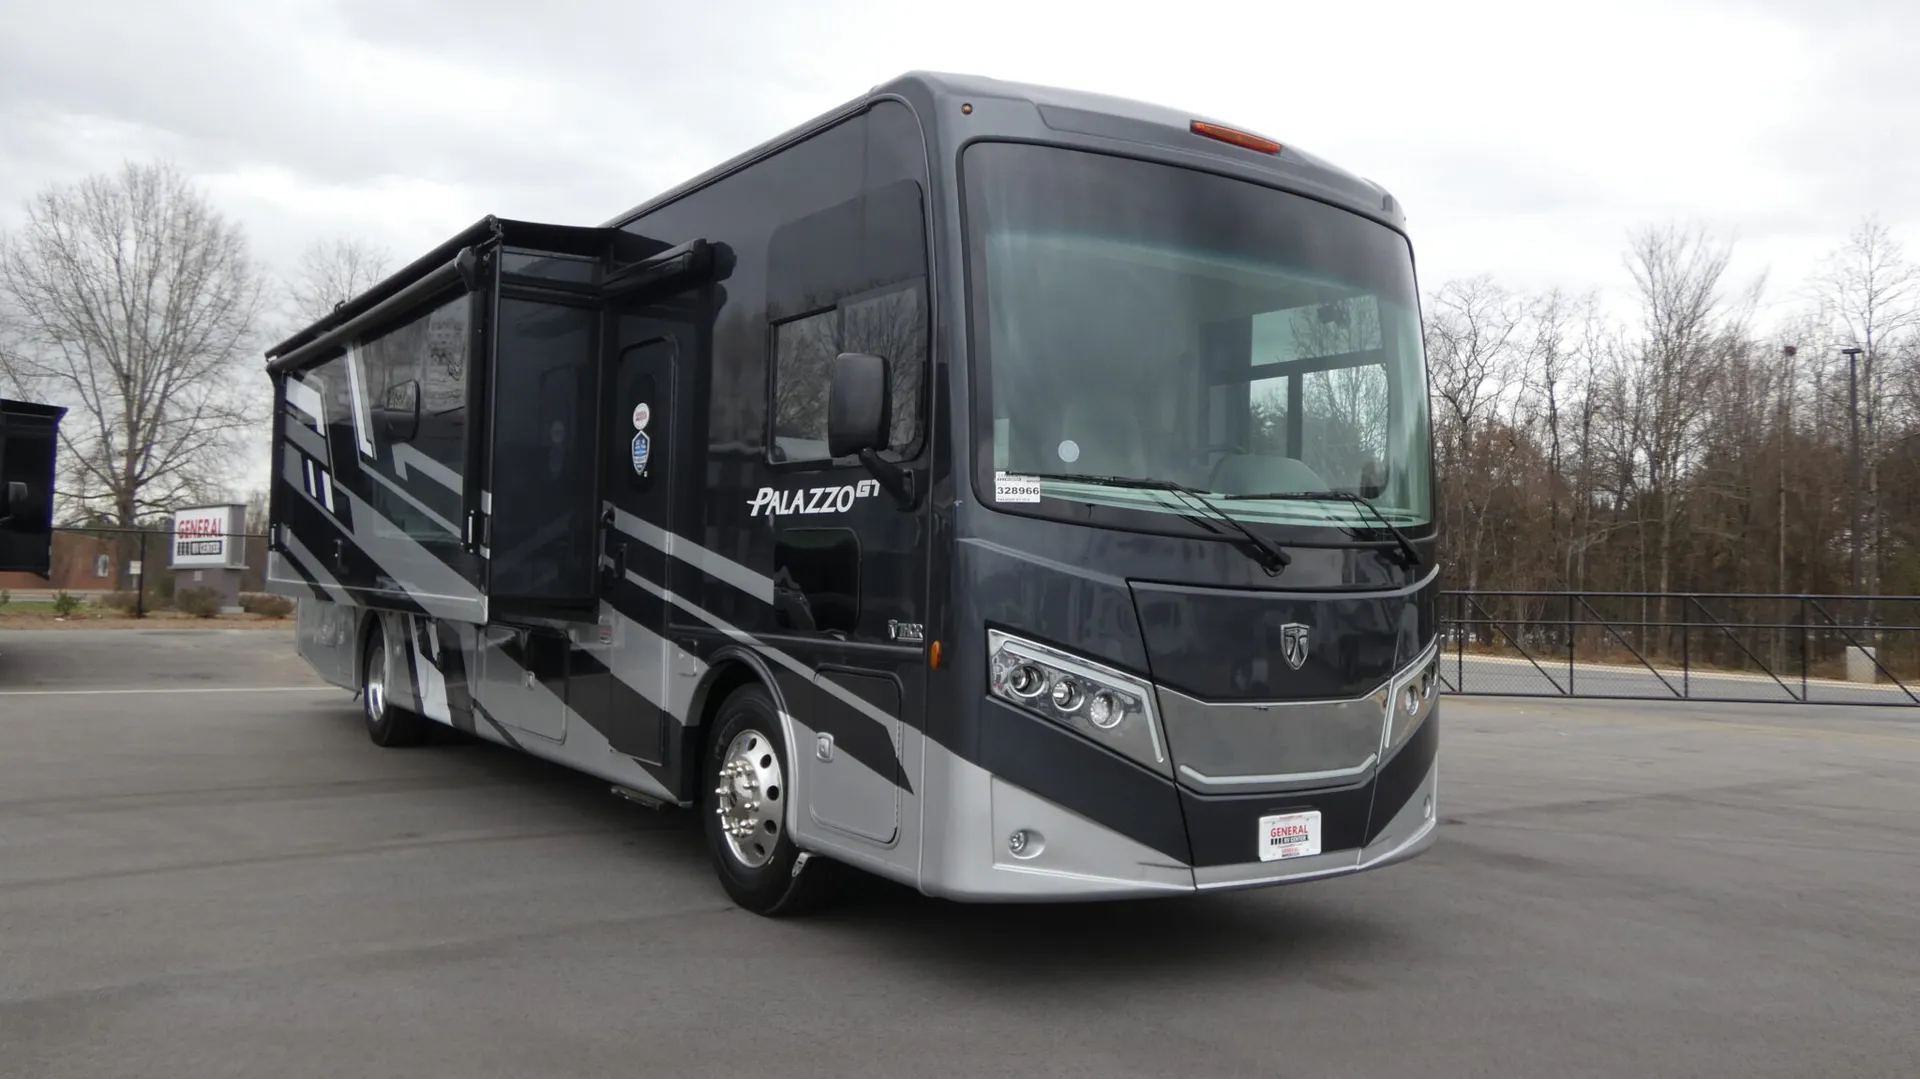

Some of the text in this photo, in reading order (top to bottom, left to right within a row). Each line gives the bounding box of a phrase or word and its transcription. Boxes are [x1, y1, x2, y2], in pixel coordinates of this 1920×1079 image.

[997, 486, 1040, 495] 328966
[746, 485, 855, 516] PALAZZO
[1270, 824, 1309, 838] GENERAL
